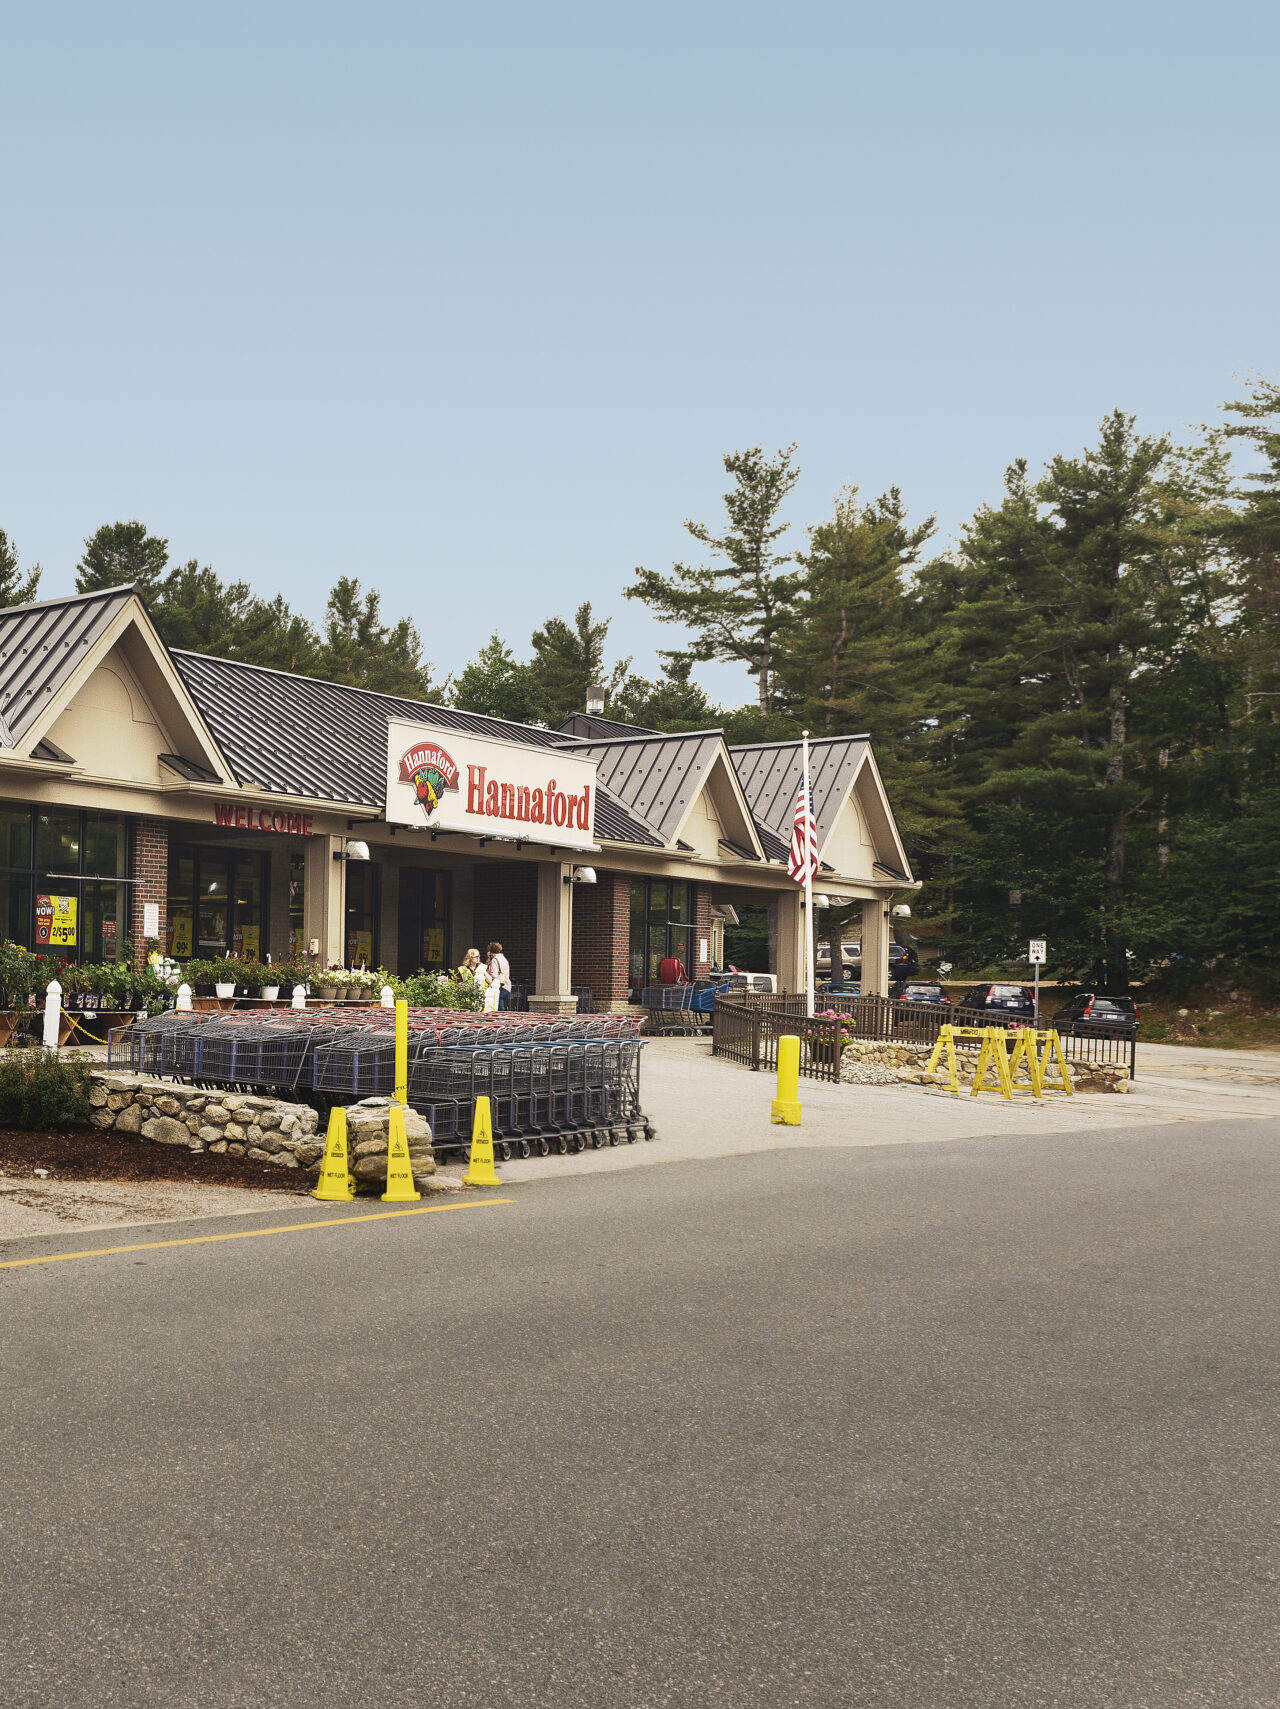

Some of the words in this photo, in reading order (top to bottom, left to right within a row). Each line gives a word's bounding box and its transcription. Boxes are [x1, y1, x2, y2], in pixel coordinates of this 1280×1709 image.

[404, 748, 456, 779] Hannaford
[465, 764, 590, 831] Hannaford
[214, 803, 314, 836] WELCOME
